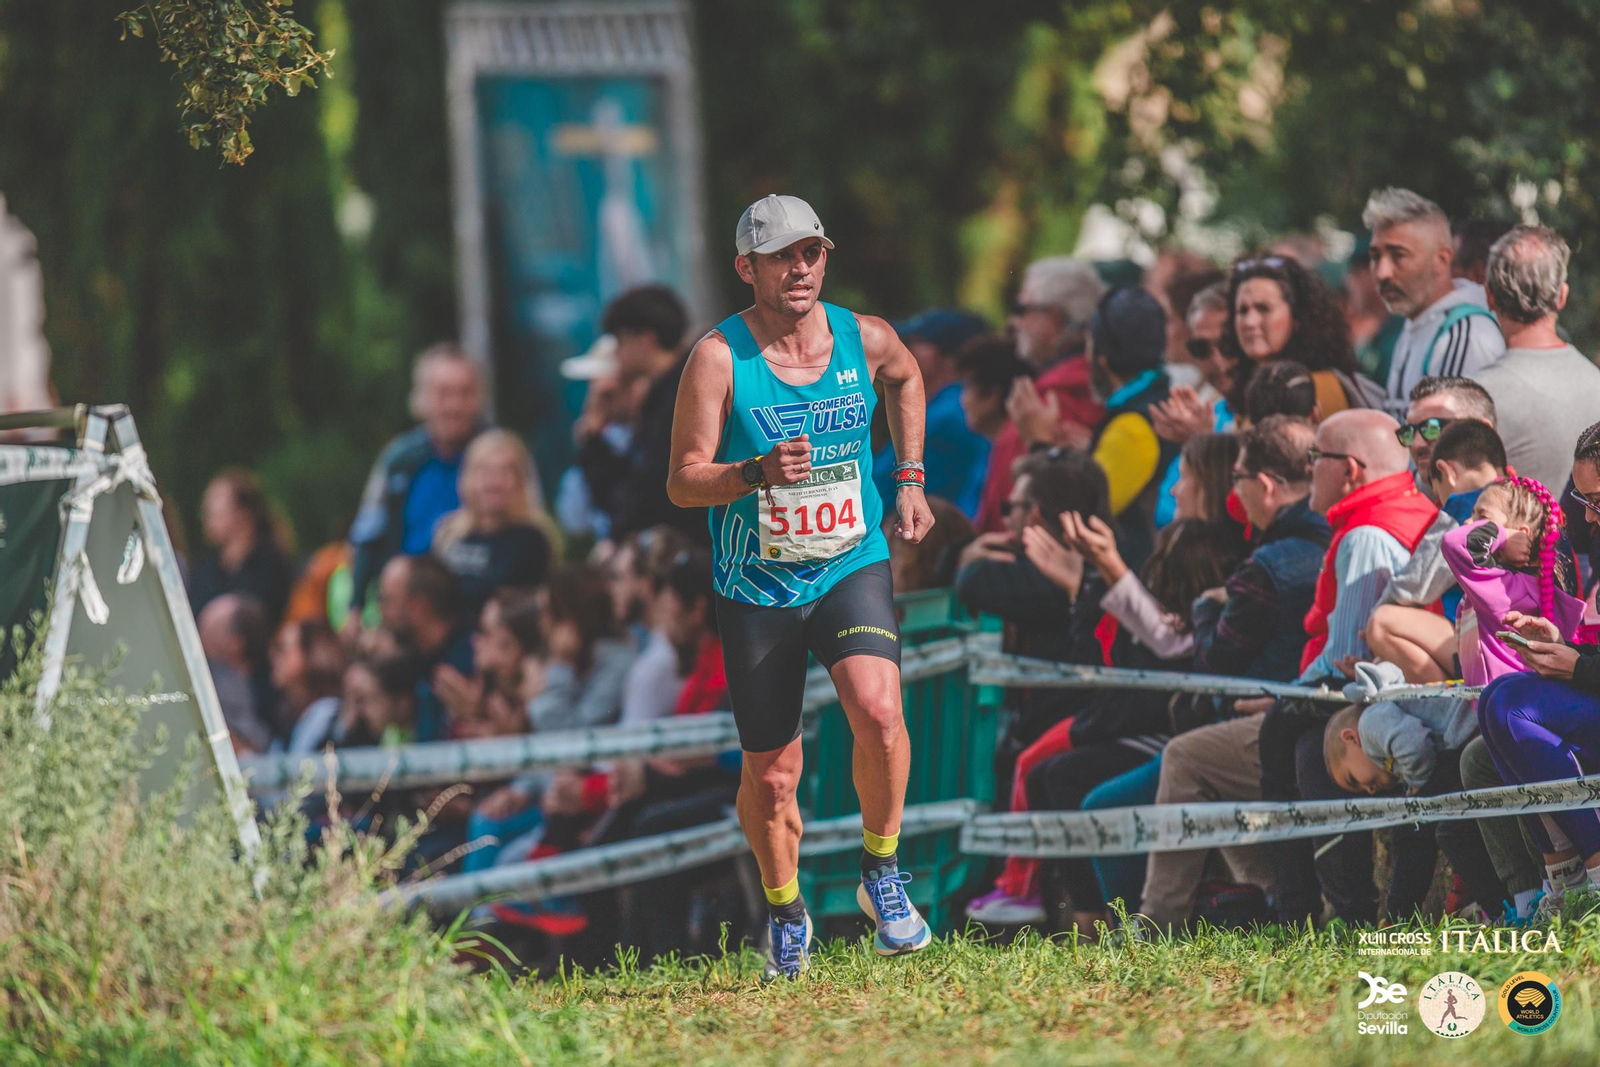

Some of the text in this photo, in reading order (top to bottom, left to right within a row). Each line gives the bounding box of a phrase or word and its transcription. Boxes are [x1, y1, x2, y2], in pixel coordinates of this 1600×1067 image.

[836, 368, 858, 385] HH
[811, 392, 864, 412] COMERCIAL
[813, 403, 867, 434] ULSA
[811, 440, 861, 462] TISMO
[797, 470, 837, 485] ALICA
[769, 498, 857, 536] 5104
[837, 625, 898, 642] CD BOTIJOSPORT
